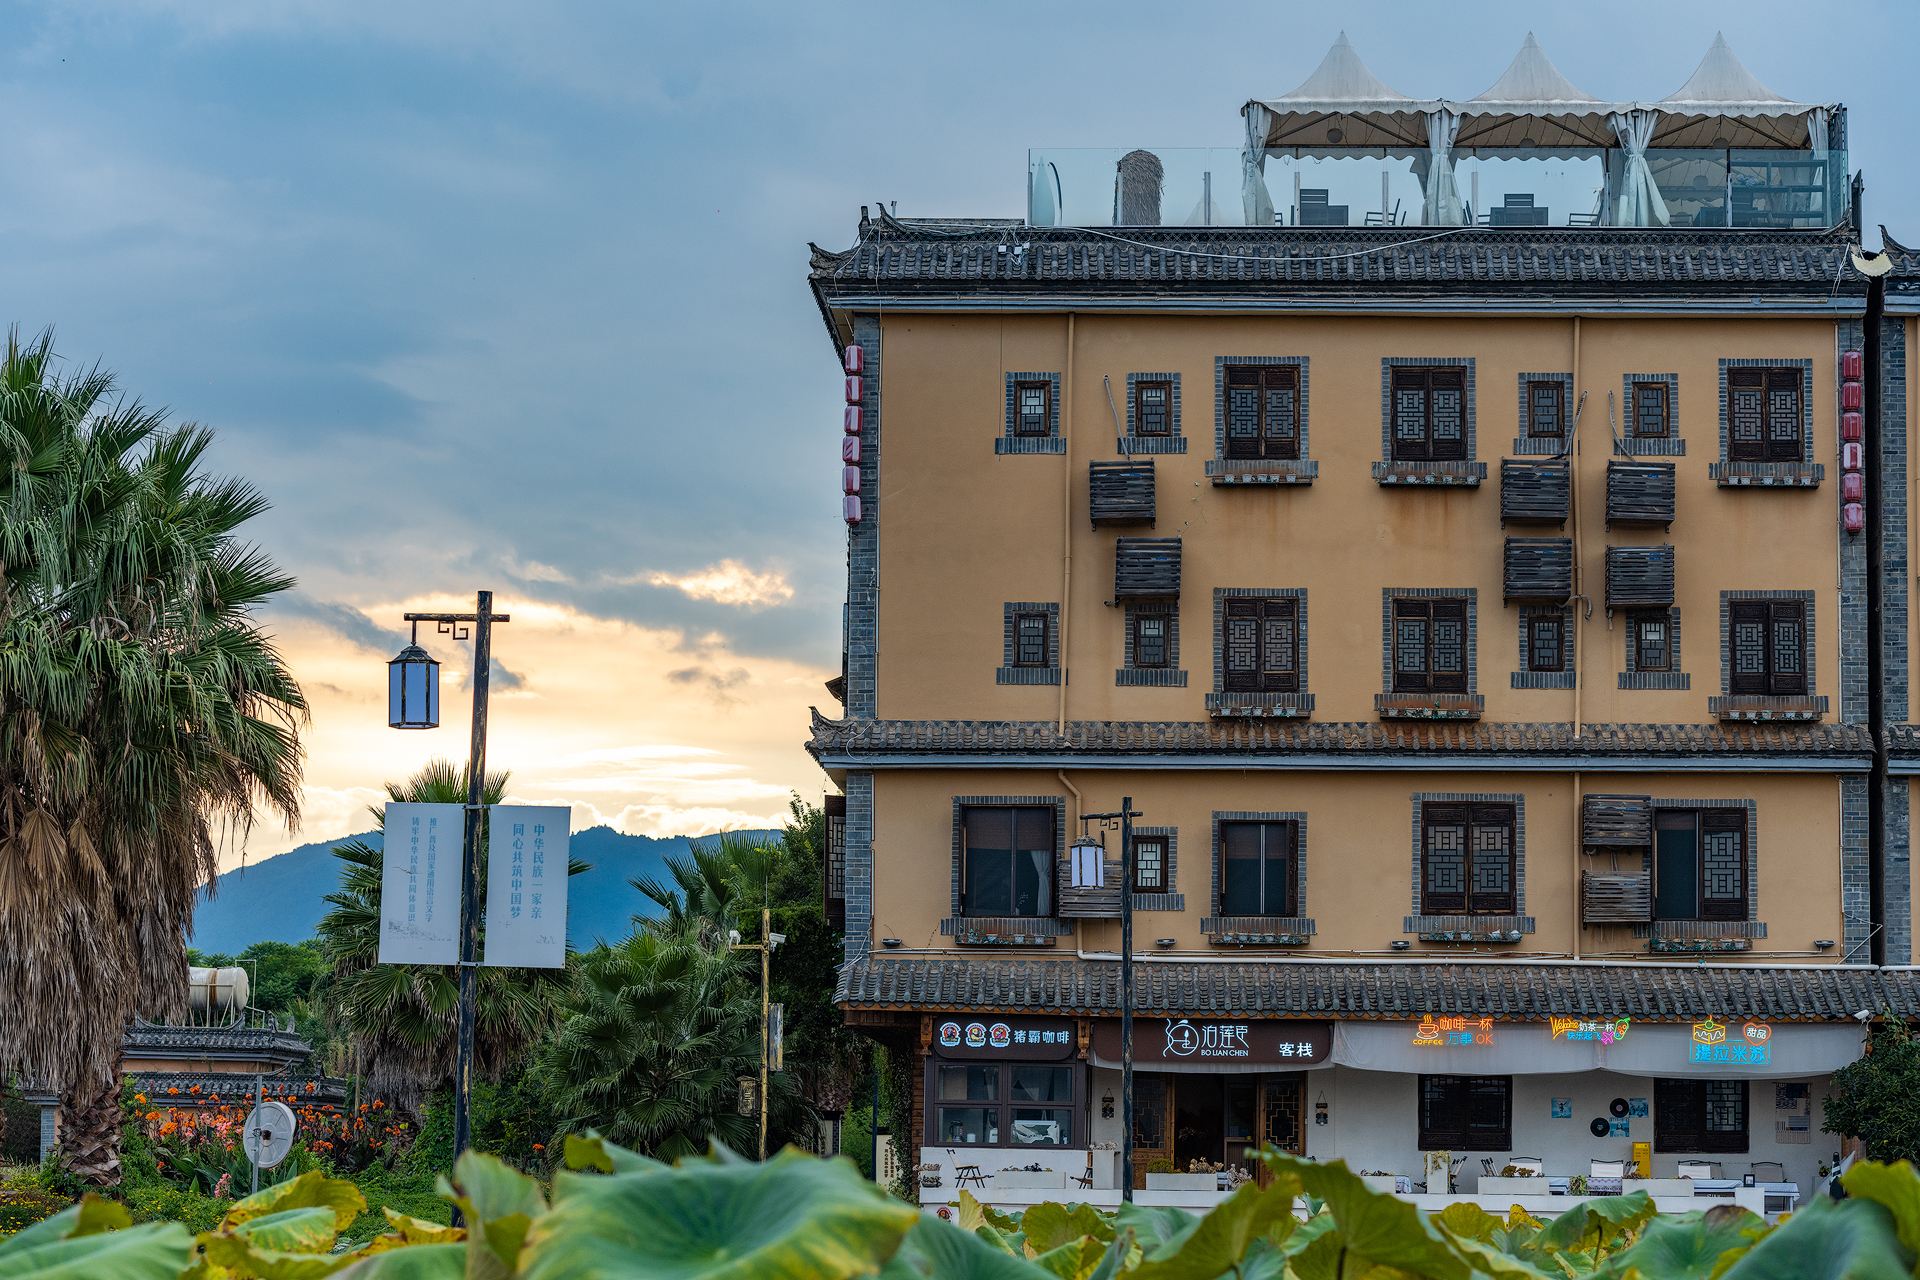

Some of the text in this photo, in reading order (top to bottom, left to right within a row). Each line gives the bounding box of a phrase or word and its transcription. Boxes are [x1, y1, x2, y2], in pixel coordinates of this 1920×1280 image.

[407, 816, 420, 922] 铸牢中华民族共同体意识
[425, 817, 437, 923] 推广普及国家通用语言文字
[510, 823, 525, 919] 同心共筑中国梦
[530, 823, 545, 919] 中华民族一家亲
[1439, 1017, 1494, 1032] 咖啡一杯
[1579, 1022, 1614, 1032] 奶茶一杯
[1013, 1029, 1070, 1045] 猪霸咖啡
[1446, 1032, 1494, 1046] 万事 OK
[1567, 1031, 1601, 1041] 快乐起飞
[1746, 1027, 1767, 1039] 甜品
[1279, 1042, 1314, 1058] 客栈
[1412, 1038, 1444, 1046] COFFEE
[1695, 1044, 1767, 1063] 提拉米苏
